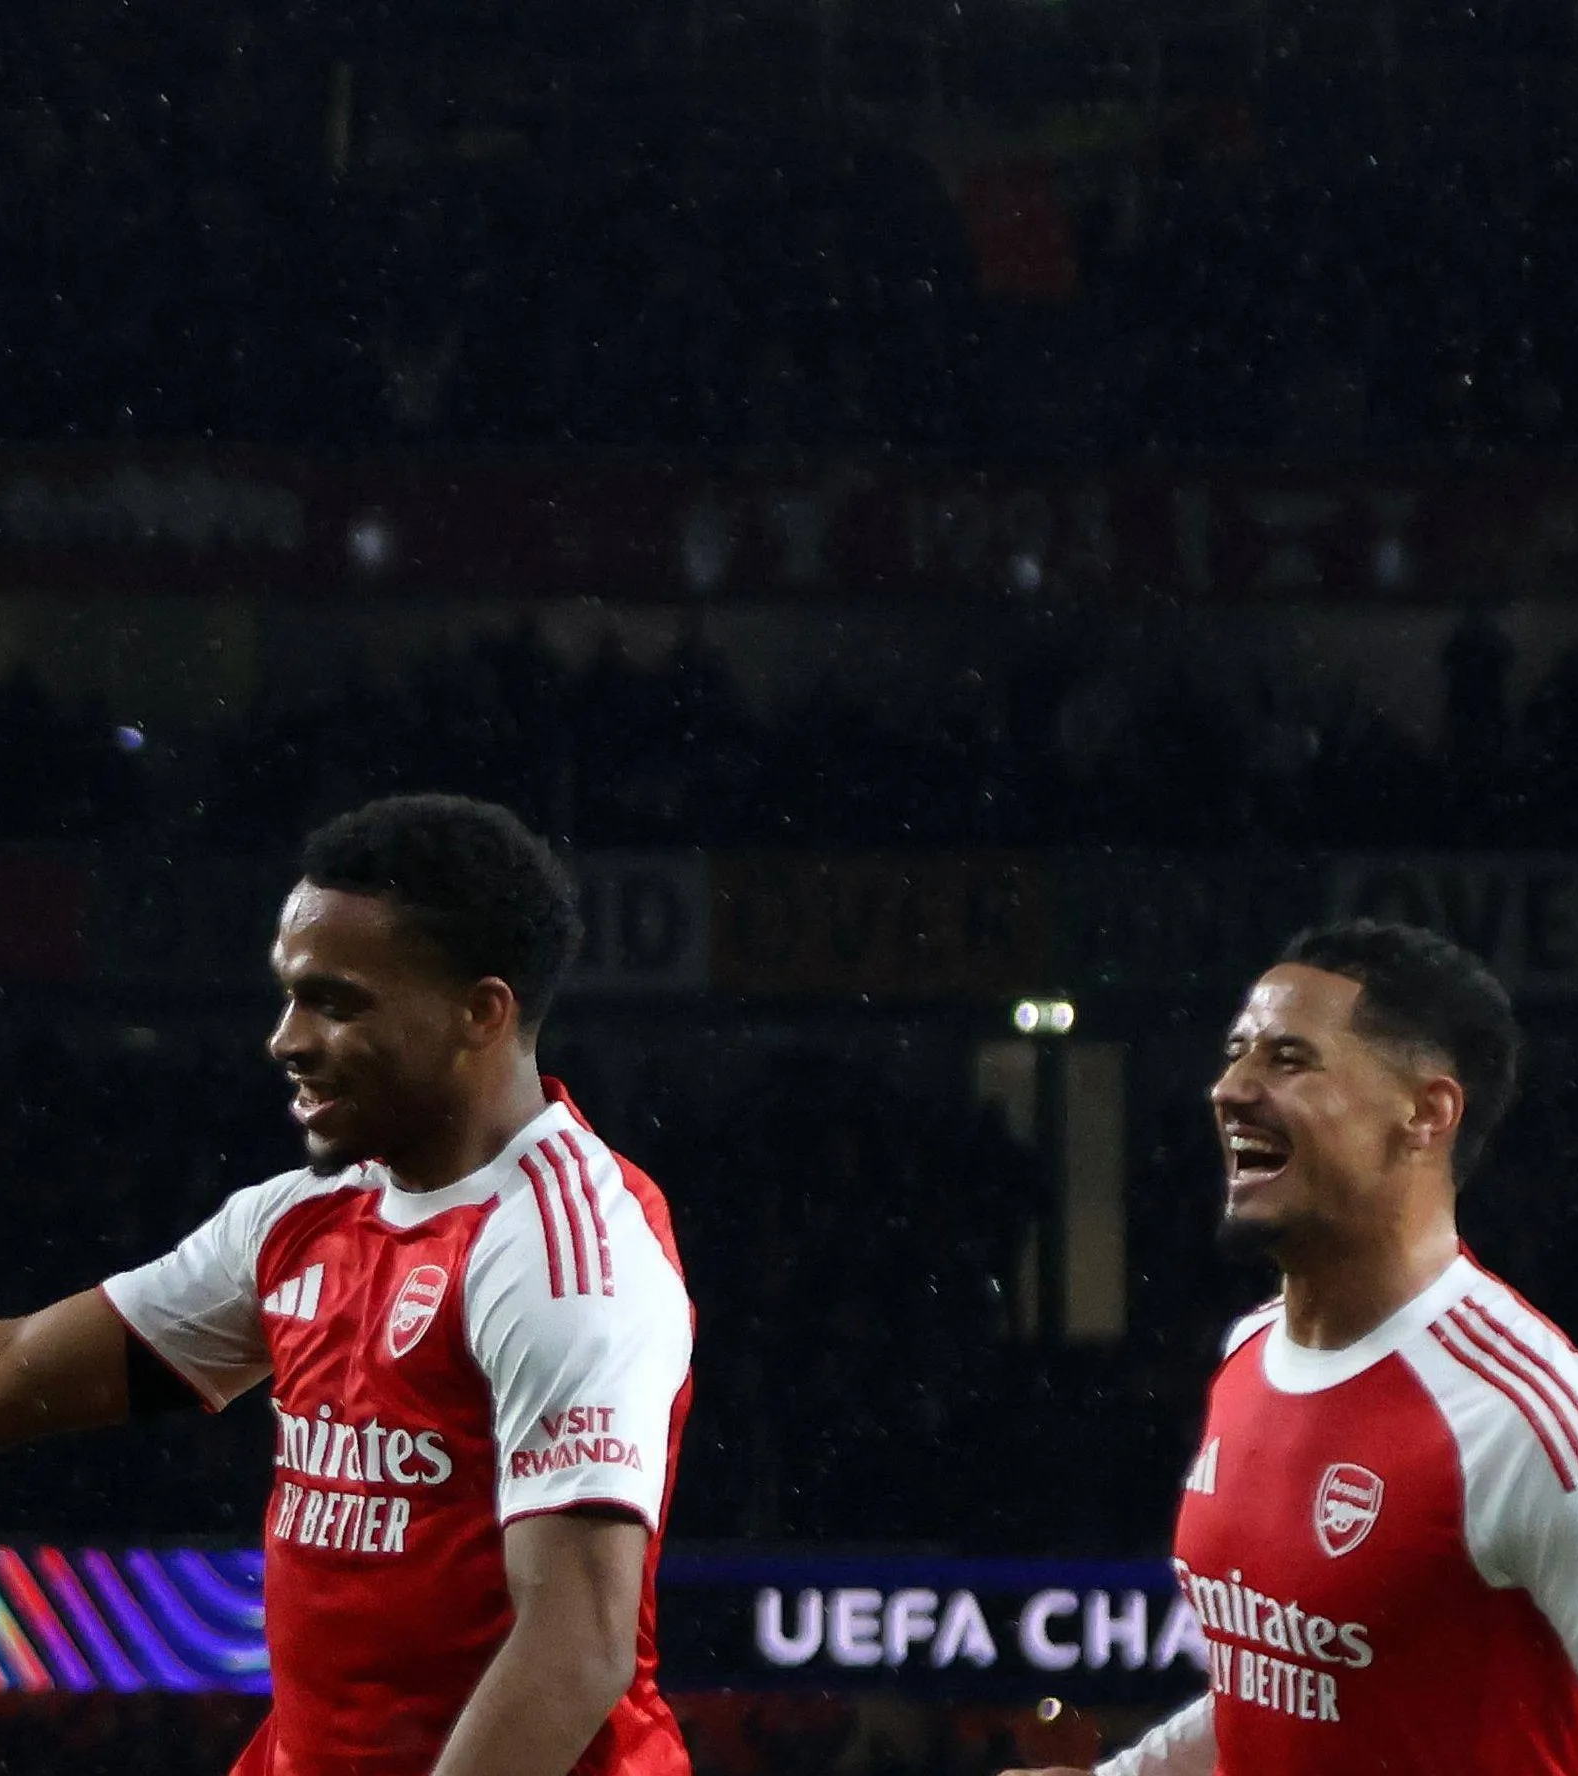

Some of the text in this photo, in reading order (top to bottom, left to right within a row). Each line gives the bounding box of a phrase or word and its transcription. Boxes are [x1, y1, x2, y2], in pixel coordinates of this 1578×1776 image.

[511, 1437, 644, 1480] RWANDA
[298, 1488, 411, 1553] BETTER
[755, 1587, 999, 1669] UEFA
[1239, 1648, 1340, 1722] BETTER
